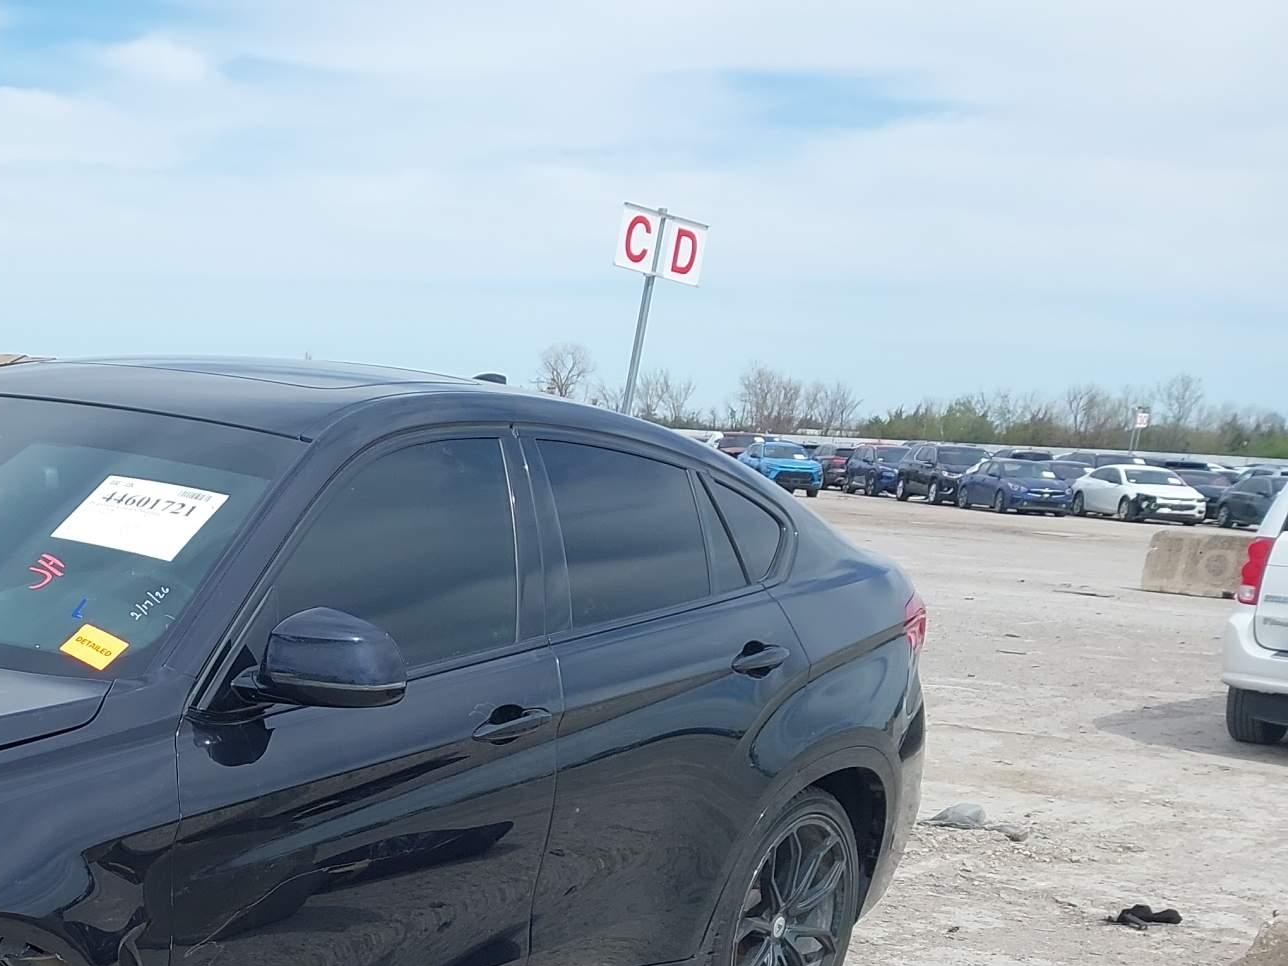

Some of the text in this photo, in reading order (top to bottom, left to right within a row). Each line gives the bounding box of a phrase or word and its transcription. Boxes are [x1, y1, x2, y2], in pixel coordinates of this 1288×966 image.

[625, 215, 698, 275] C D
[101, 491, 197, 517] 44601721
[129, 586, 170, 621] 2/17/26
[75, 635, 113, 657] DETAILED
